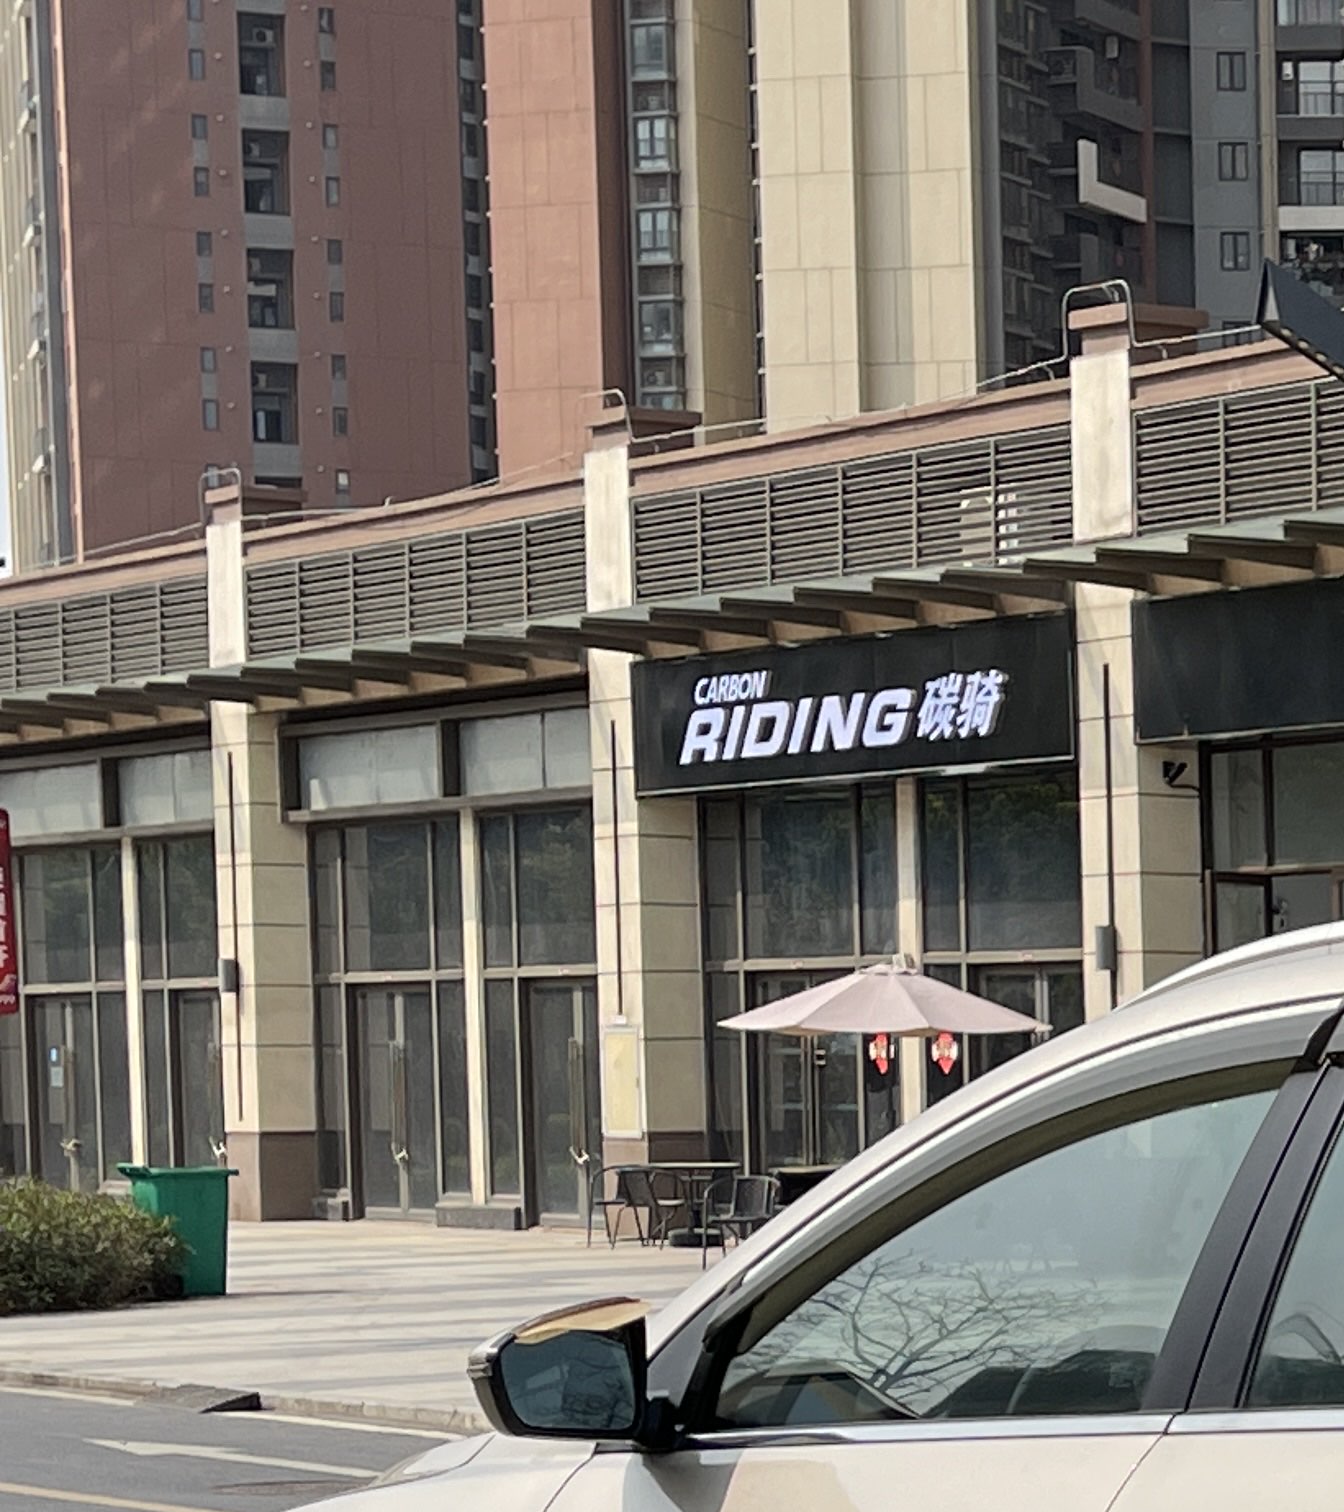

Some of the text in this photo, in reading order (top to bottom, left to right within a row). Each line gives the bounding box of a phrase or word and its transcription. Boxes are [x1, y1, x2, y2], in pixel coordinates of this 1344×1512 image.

[679, 669, 1009, 766] RIDING 碳骑
[695, 670, 768, 704] CARBON
